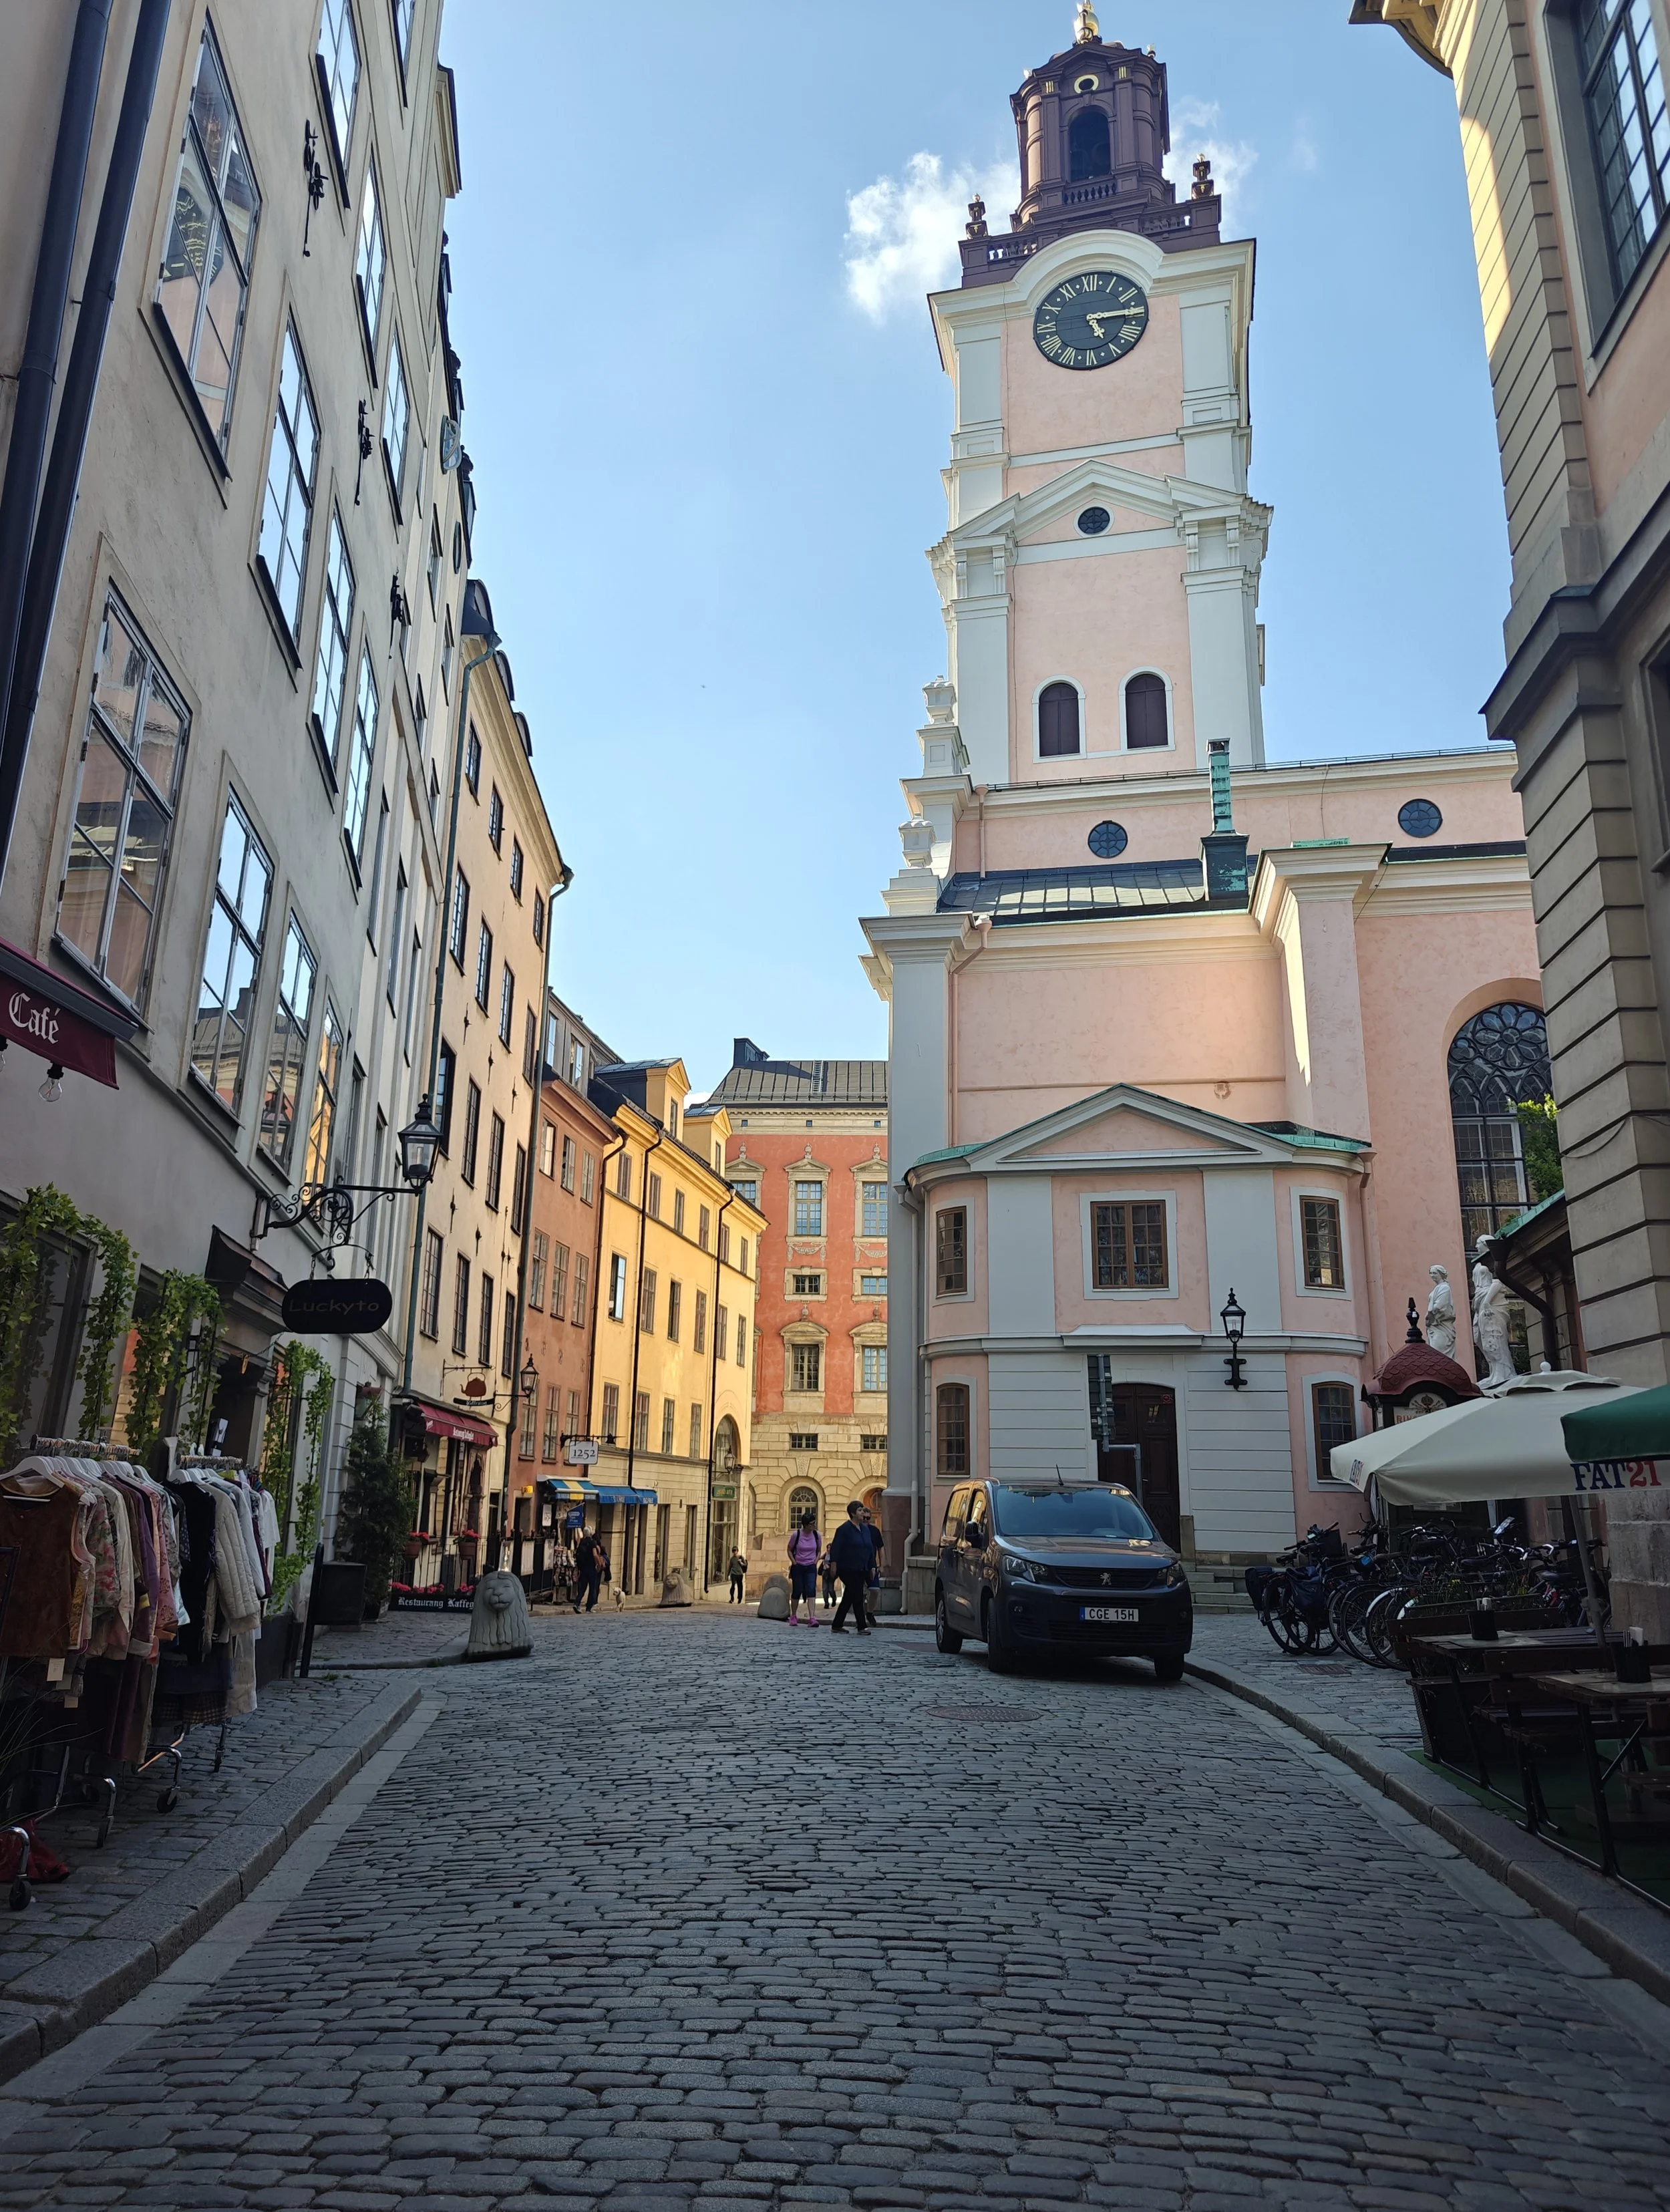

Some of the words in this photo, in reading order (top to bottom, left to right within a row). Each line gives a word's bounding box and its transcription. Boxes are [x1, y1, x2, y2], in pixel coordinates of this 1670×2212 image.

[1058, 283, 1077, 301] XI
[1081, 275, 1098, 293] XII
[1106, 276, 1117, 293] I
[1118, 287, 1138, 303] II
[1042, 302, 1061, 315] X
[1037, 321, 1056, 333] IX
[1040, 335, 1062, 357] VIII
[1108, 342, 1122, 357] V
[1058, 347, 1076, 365] VII
[1086, 349, 1098, 365] VI
[9, 992, 61, 1044] Café
[289, 1299, 379, 1315] Luckyto
[574, 1449, 596, 1460] 1252
[1570, 1460, 1662, 1491] FAT21
[398, 1596, 444, 1609] Restaurang
[1089, 1608, 1110, 1619] CGE
[1114, 1609, 1134, 1620] 15H
